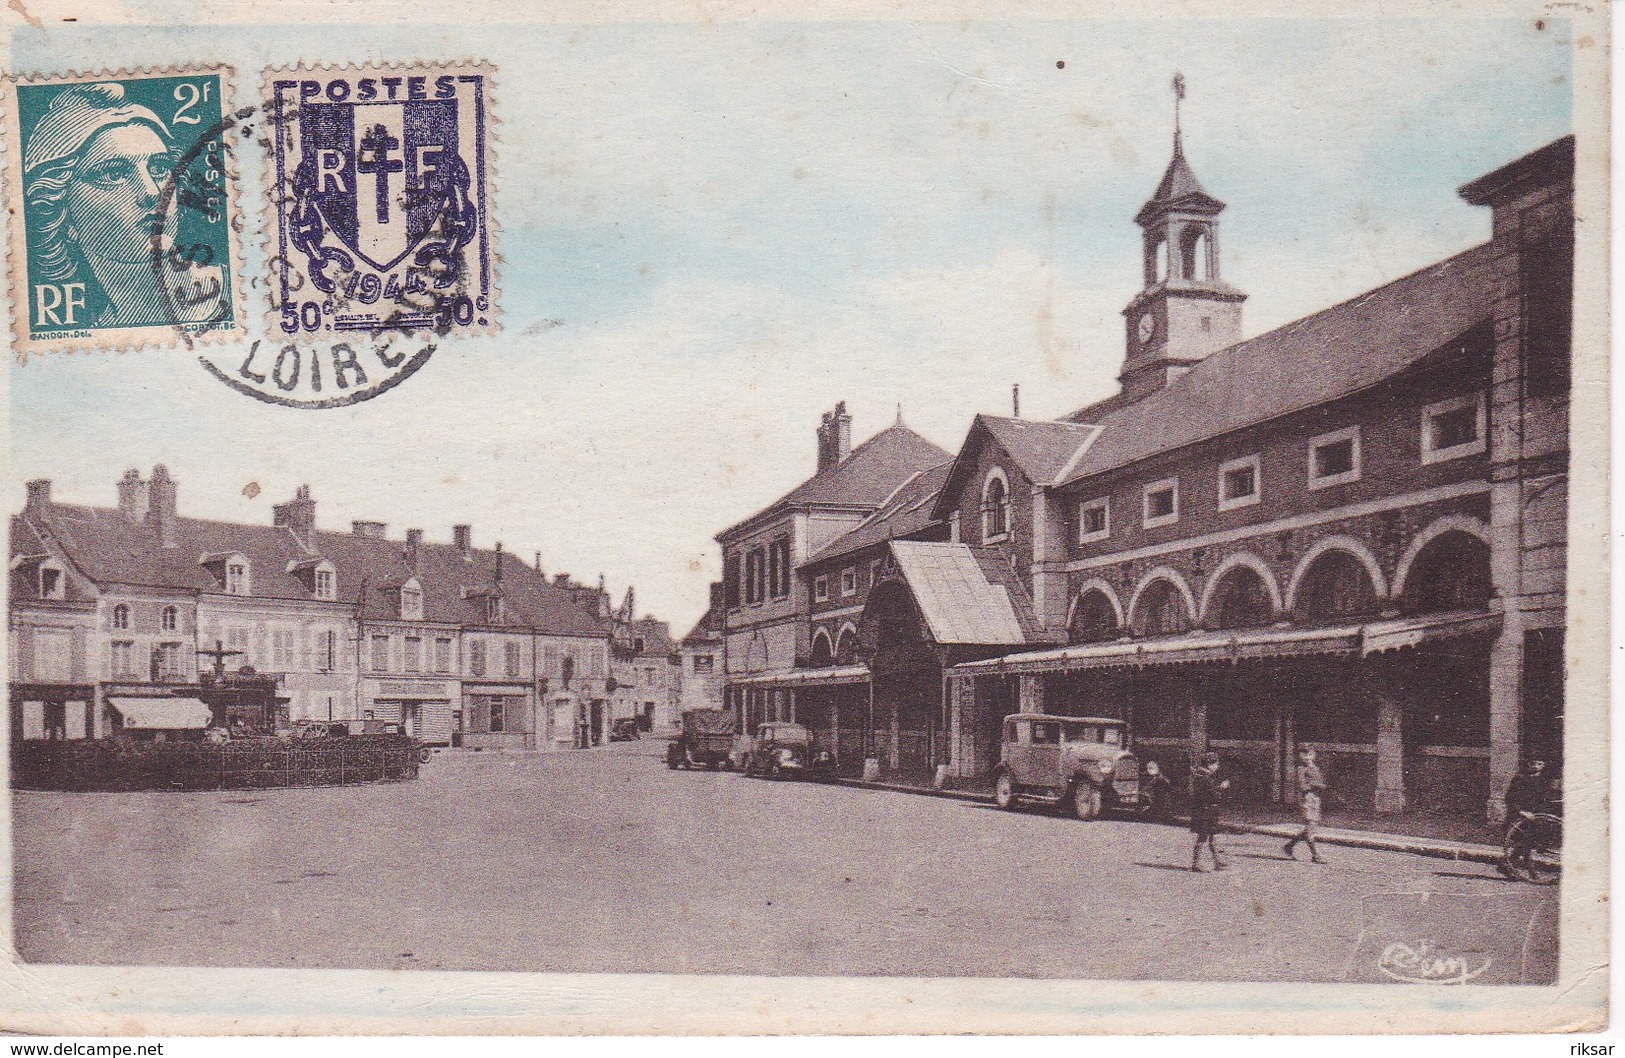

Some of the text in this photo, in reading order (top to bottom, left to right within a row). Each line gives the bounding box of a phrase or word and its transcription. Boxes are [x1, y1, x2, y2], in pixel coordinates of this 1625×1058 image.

[300, 75, 456, 104] POSTES
[34, 283, 86, 327] RF
[344, 265, 427, 305] 1944
